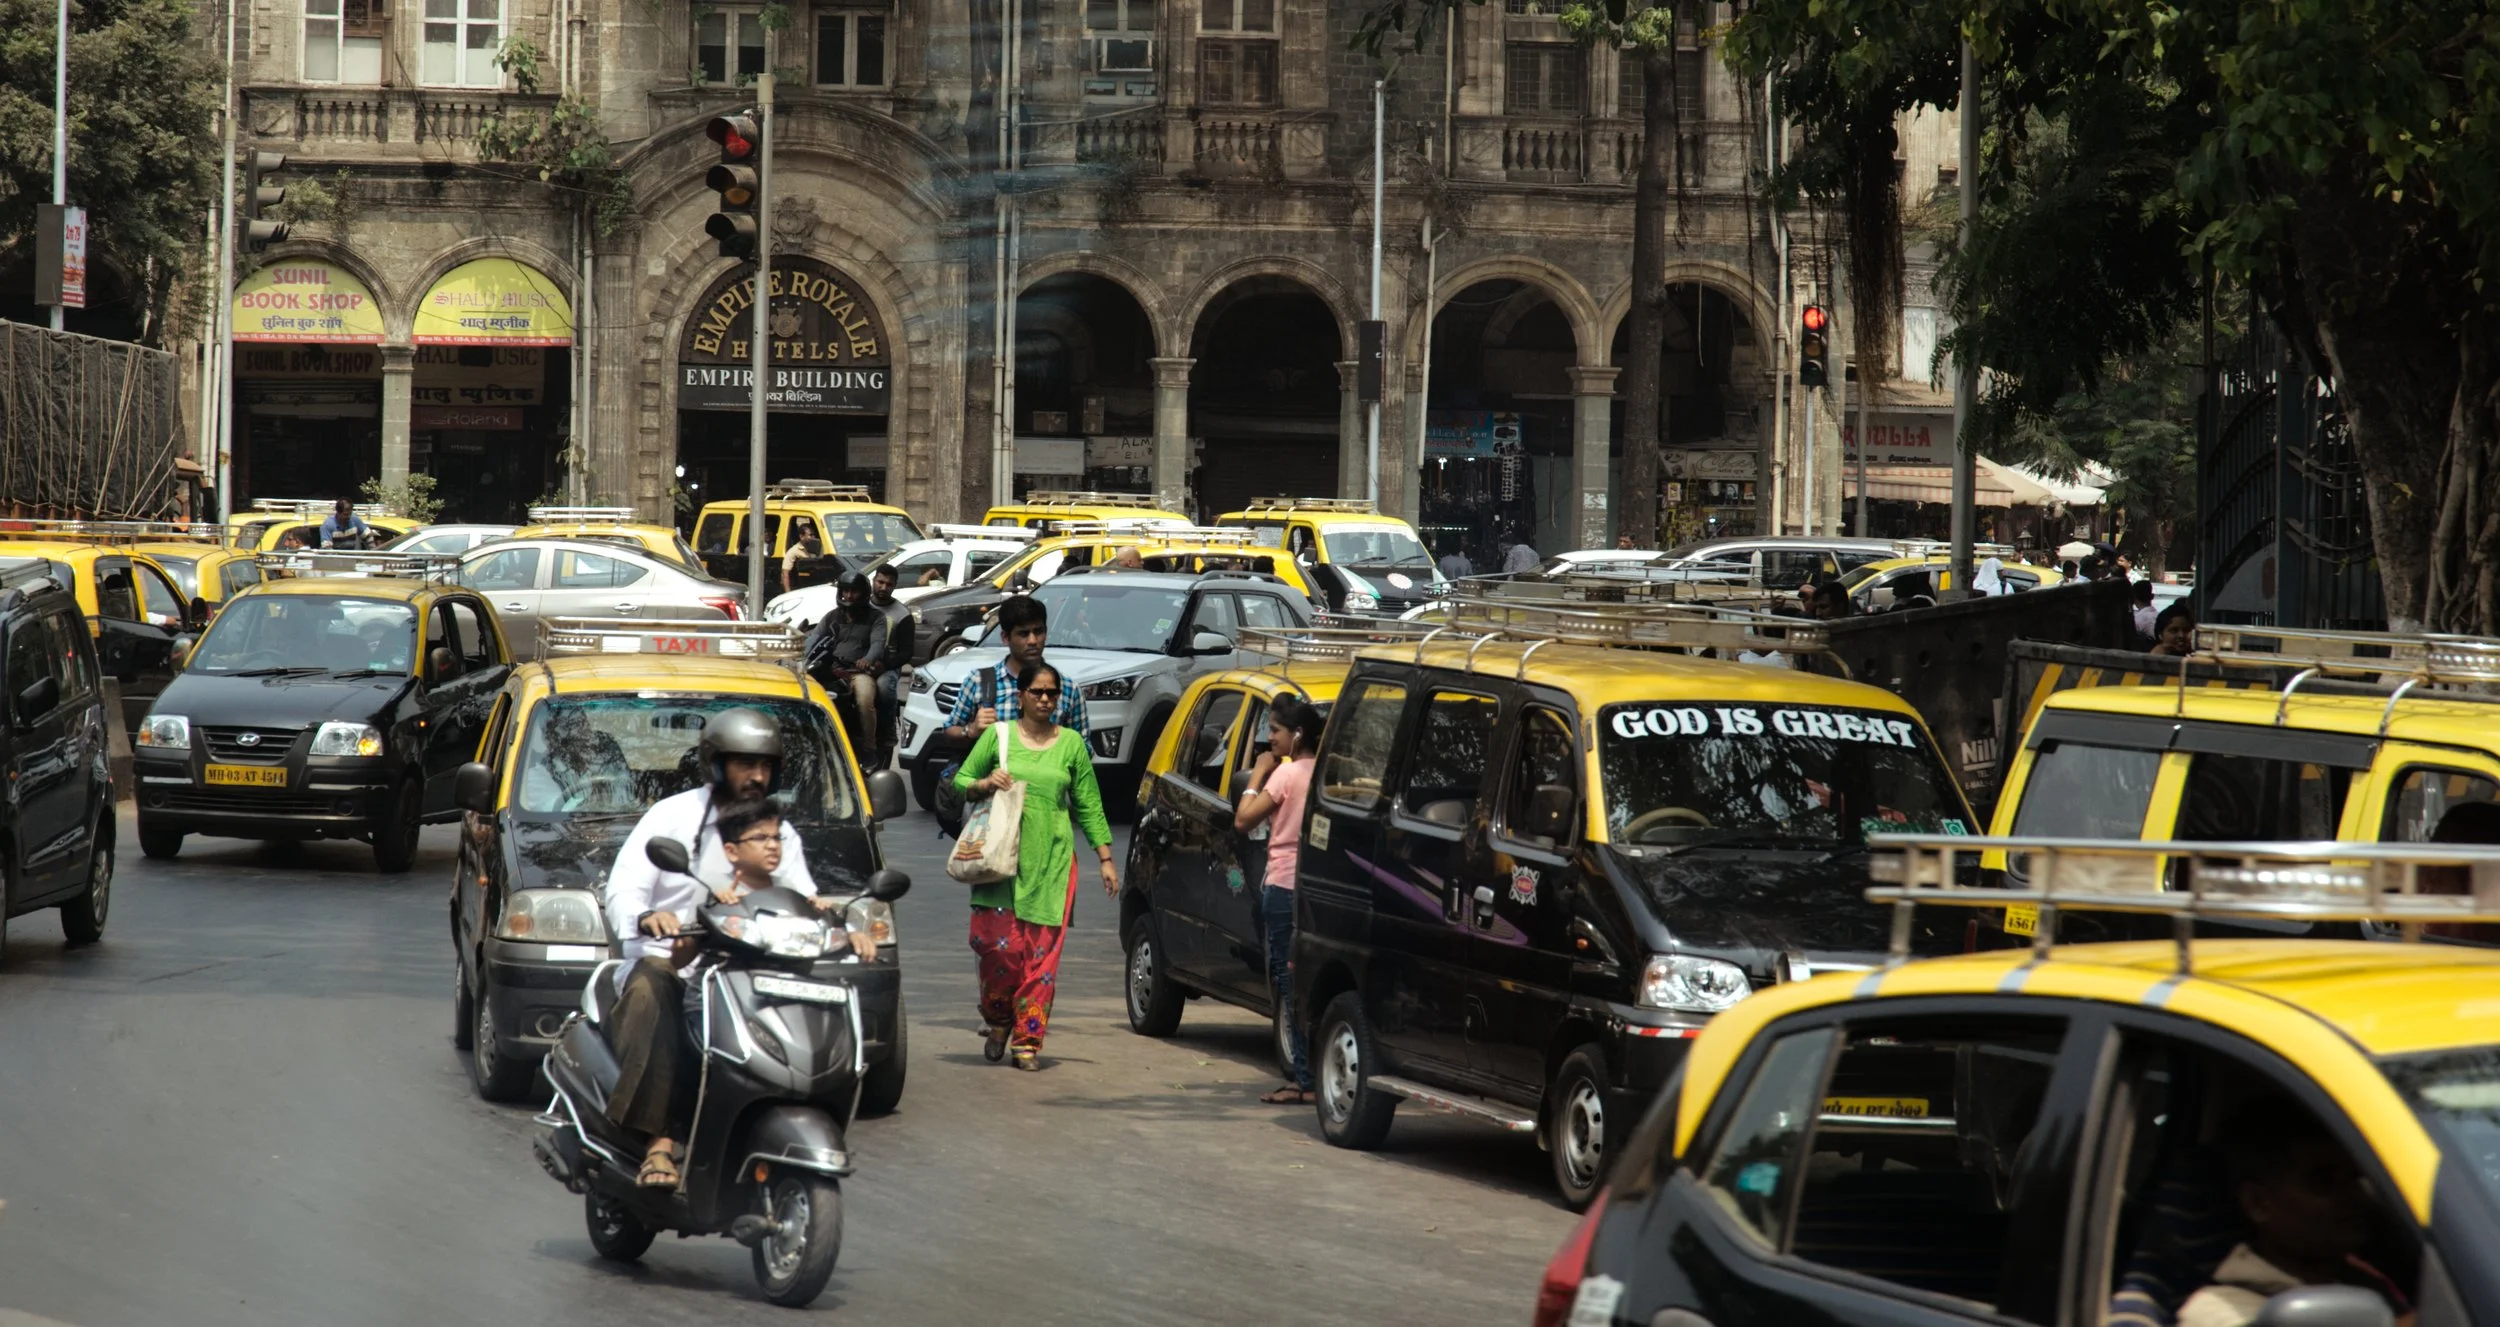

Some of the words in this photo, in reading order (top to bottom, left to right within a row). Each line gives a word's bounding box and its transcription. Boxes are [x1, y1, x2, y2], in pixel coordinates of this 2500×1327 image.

[272, 268, 331, 284] SUNIL
[241, 293, 300, 309] BOOK
[308, 293, 363, 311] SHOP
[435, 292, 495, 307] SHALU
[500, 291, 556, 307] MUSIC
[261, 315, 295, 330] सुनिल
[297, 318, 316, 330] बुक
[789, 271, 878, 359] ROYALE
[494, 348, 539, 365] USIC
[731, 341, 839, 359] HTELS
[245, 351, 286, 372] SUNIL
[335, 351, 374, 374] SHOP
[686, 368, 768, 387] EMPIR
[776, 371, 884, 390] BUILDING
[446, 411, 509, 425] Roland
[1843, 425, 1932, 447] RULLA
[651, 636, 708, 653] TAXI
[1612, 708, 1709, 738] GOD
[1715, 708, 1764, 736] IS
[1772, 709, 1917, 748] GREAT
[208, 769, 224, 781] MH
[227, 770, 240, 782] 03
[244, 771, 257, 783] AT
